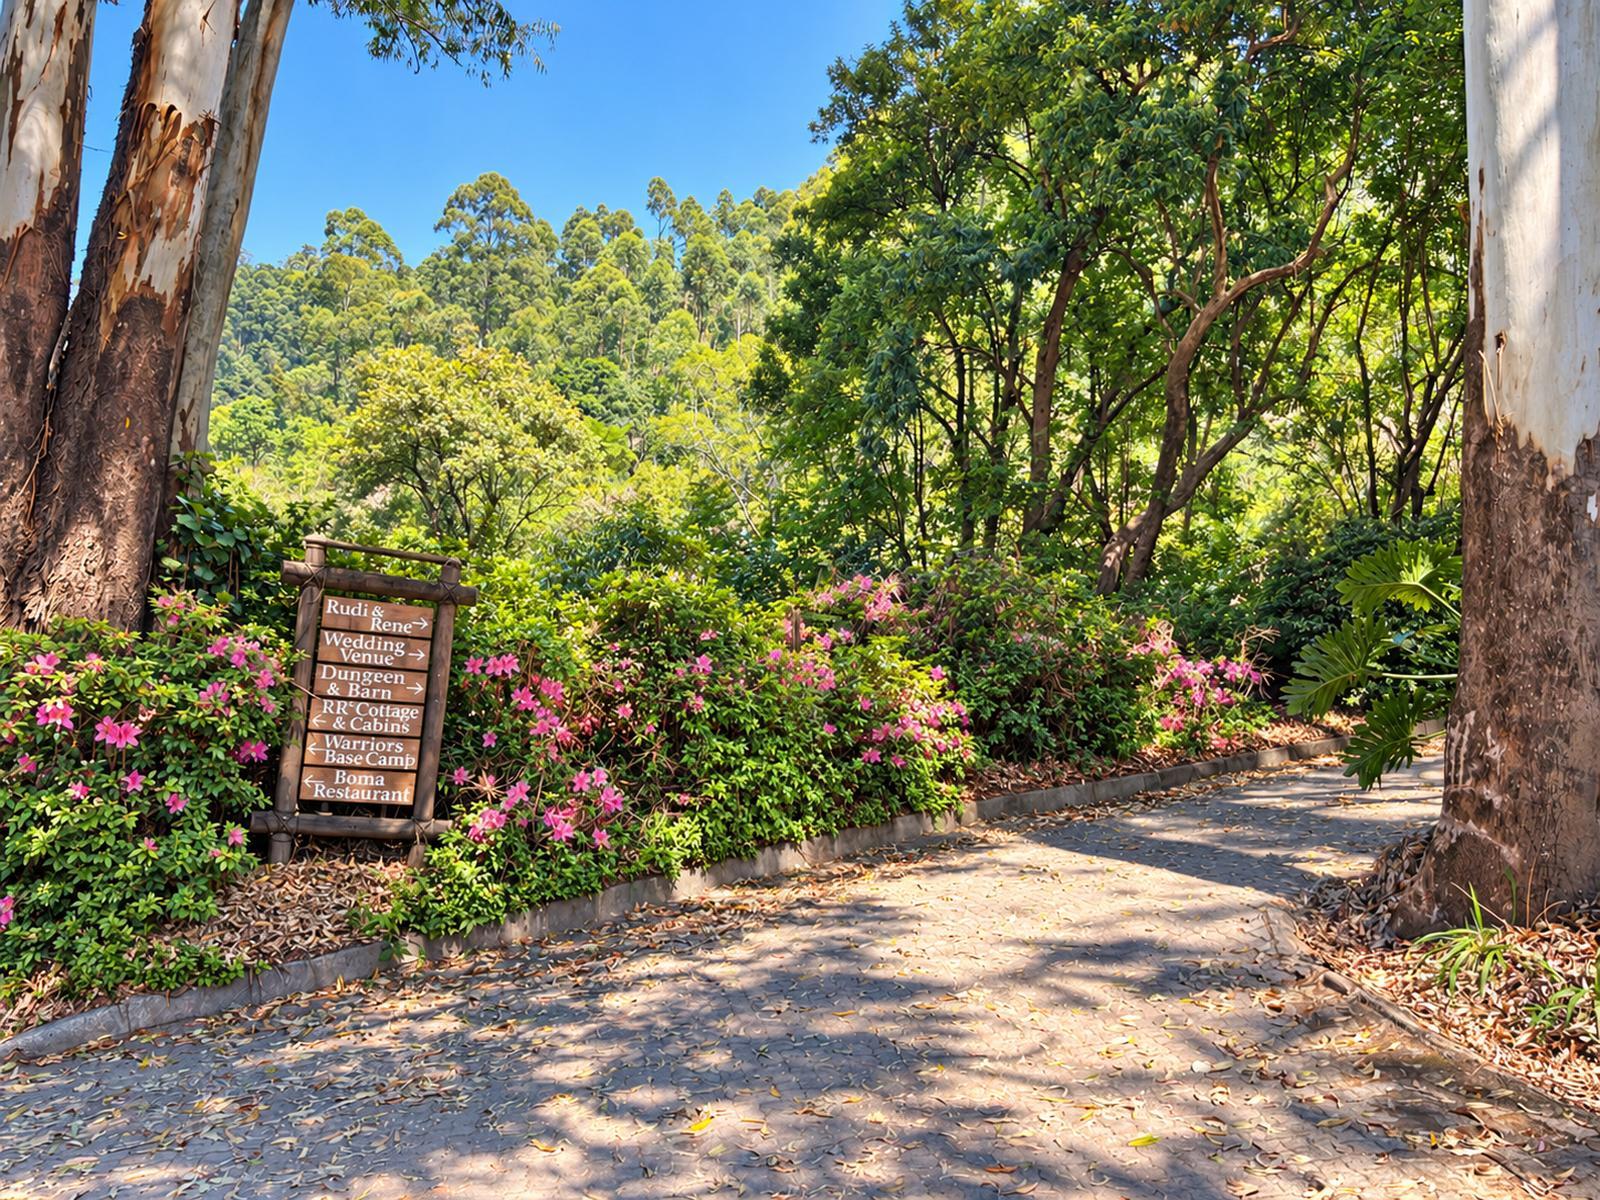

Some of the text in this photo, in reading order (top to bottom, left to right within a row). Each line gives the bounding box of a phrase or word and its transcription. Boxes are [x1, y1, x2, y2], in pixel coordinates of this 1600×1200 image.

[326, 600, 385, 618] Rudi &
[370, 617, 412, 633] Rene
[324, 631, 405, 657] Wedding
[340, 647, 394, 665] Venue
[320, 665, 405, 685] Dungeen
[327, 682, 392, 699] & Barn
[332, 716, 411, 733] & Cabins
[325, 735, 404, 753] Warriors
[325, 750, 416, 769] Base Camp
[334, 769, 385, 786] Boma
[313, 784, 411, 802] Restaurant
